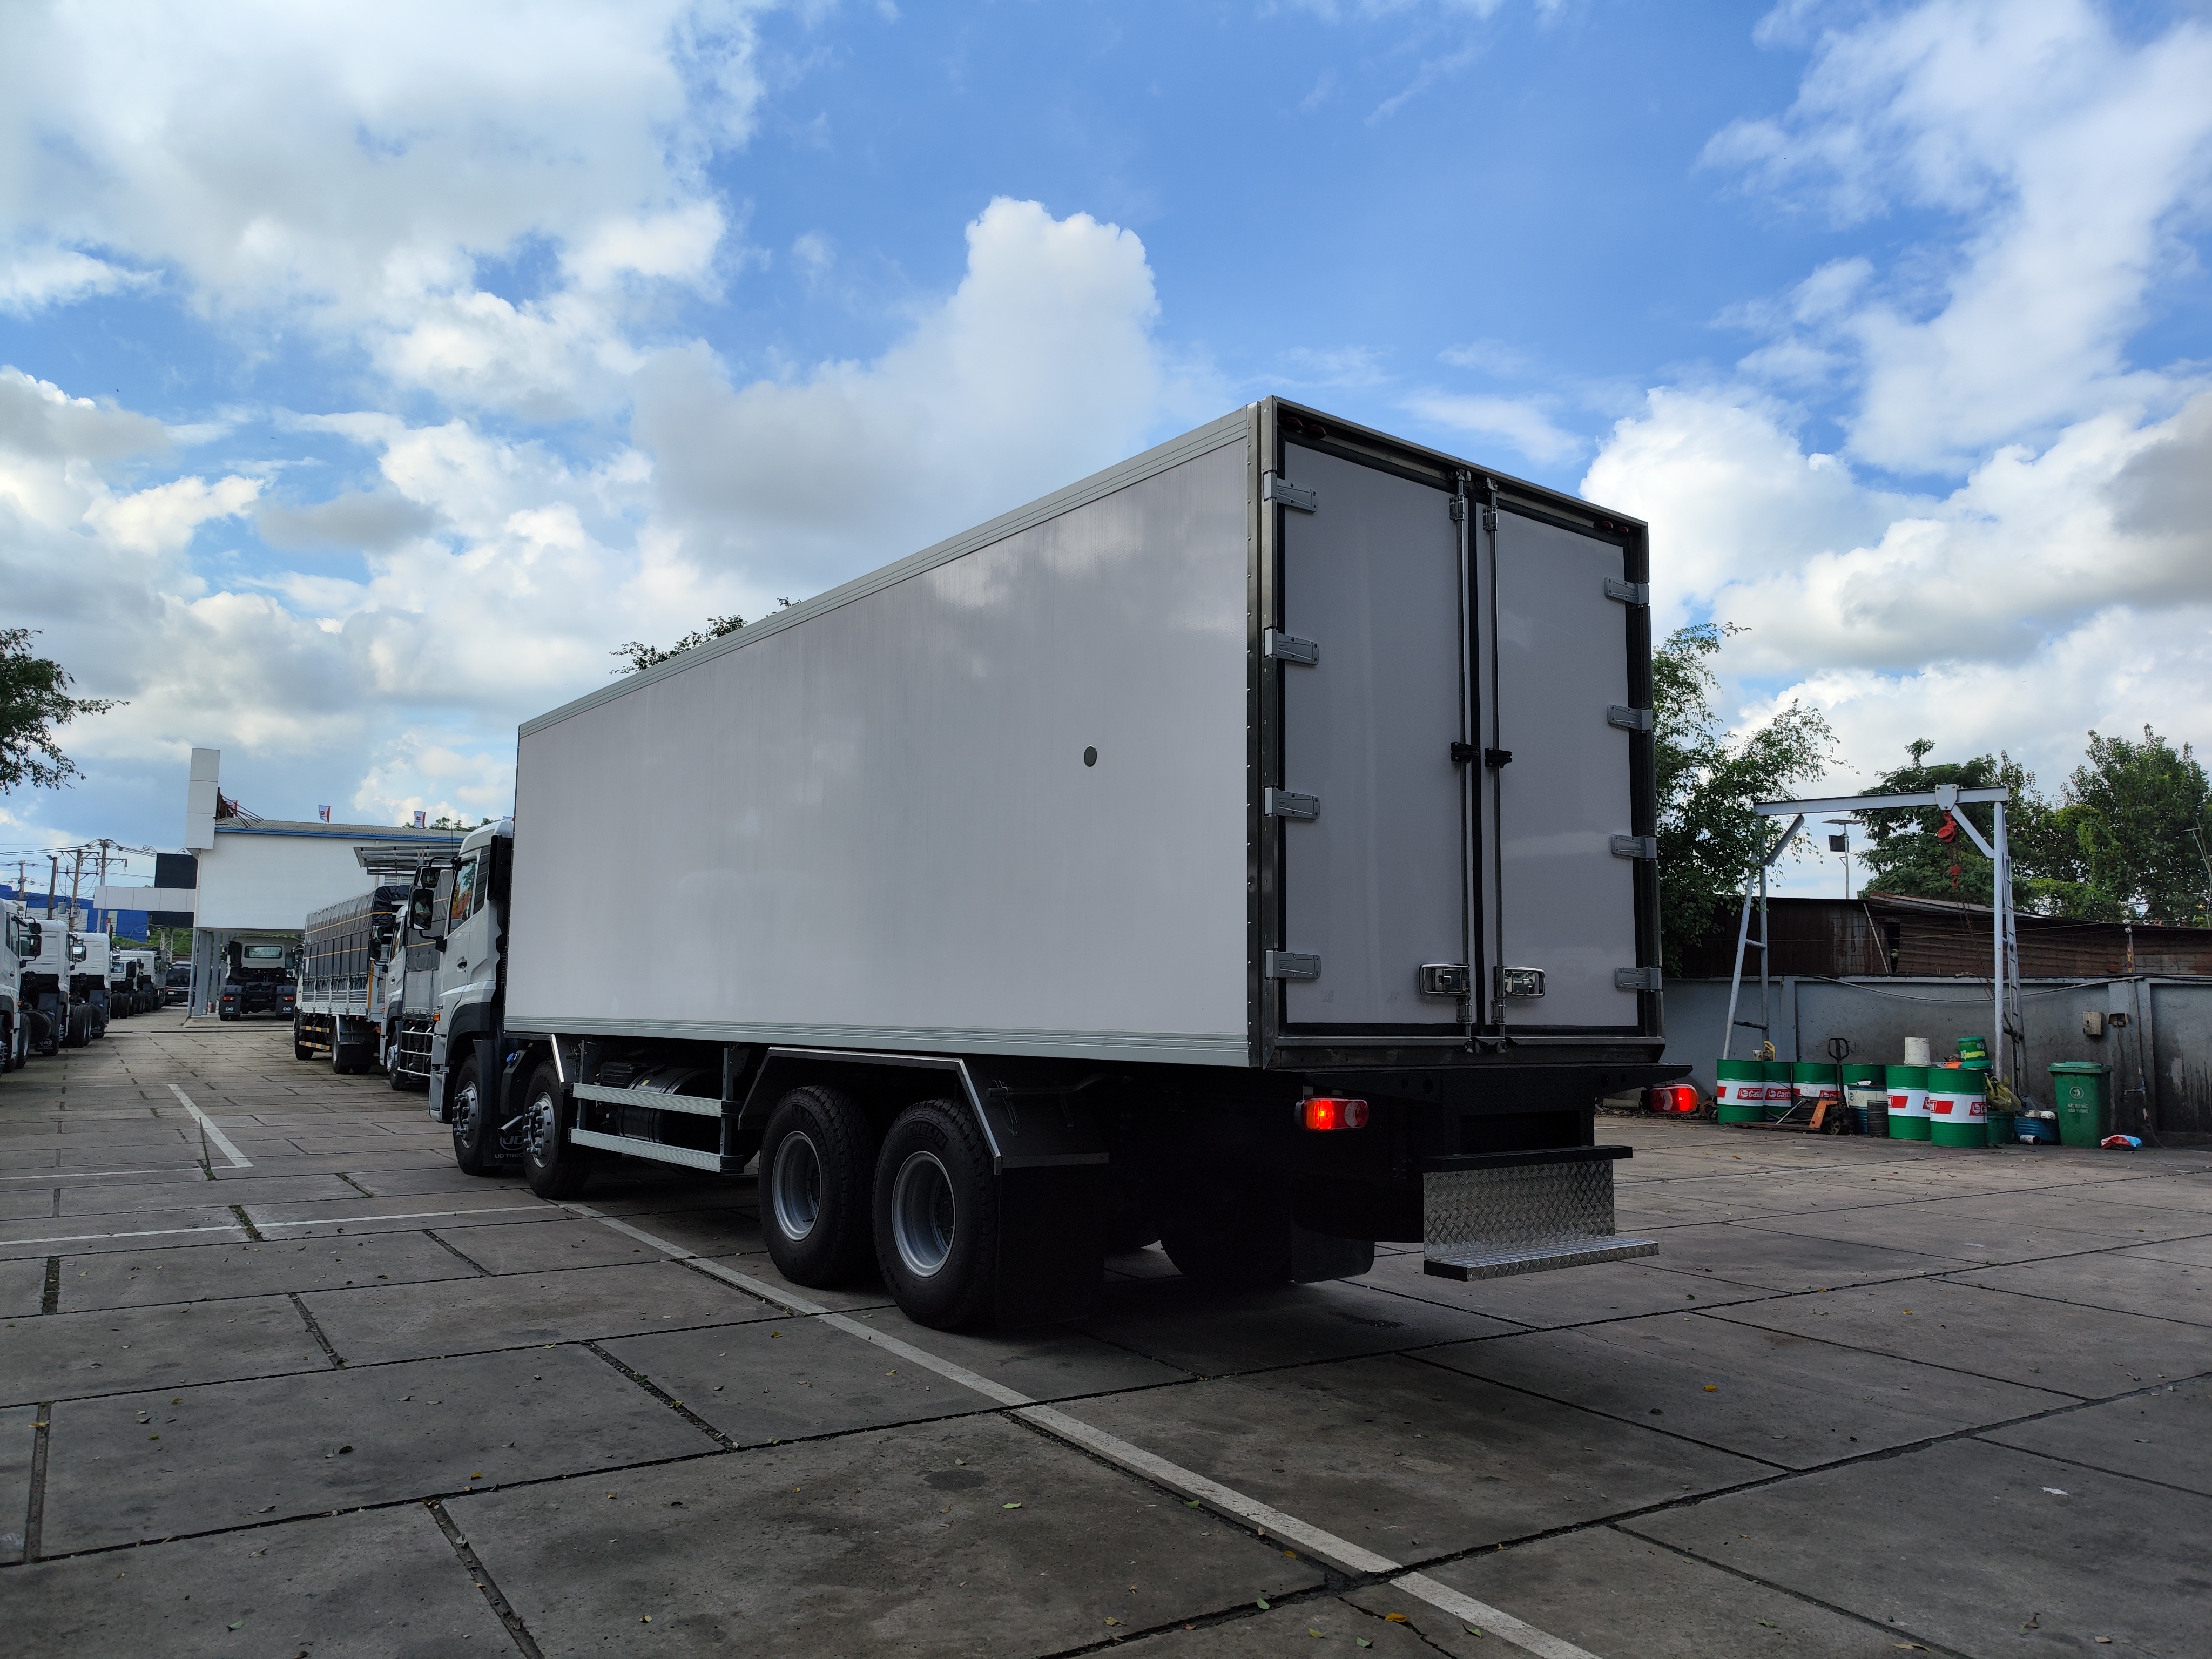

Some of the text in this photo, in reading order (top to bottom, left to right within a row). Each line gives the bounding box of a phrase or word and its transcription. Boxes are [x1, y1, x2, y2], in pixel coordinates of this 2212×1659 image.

[1748, 1090, 1763, 1098] Cast
[1776, 1090, 1791, 1098] Castr
[896, 1122, 948, 1148] ICHELIN
